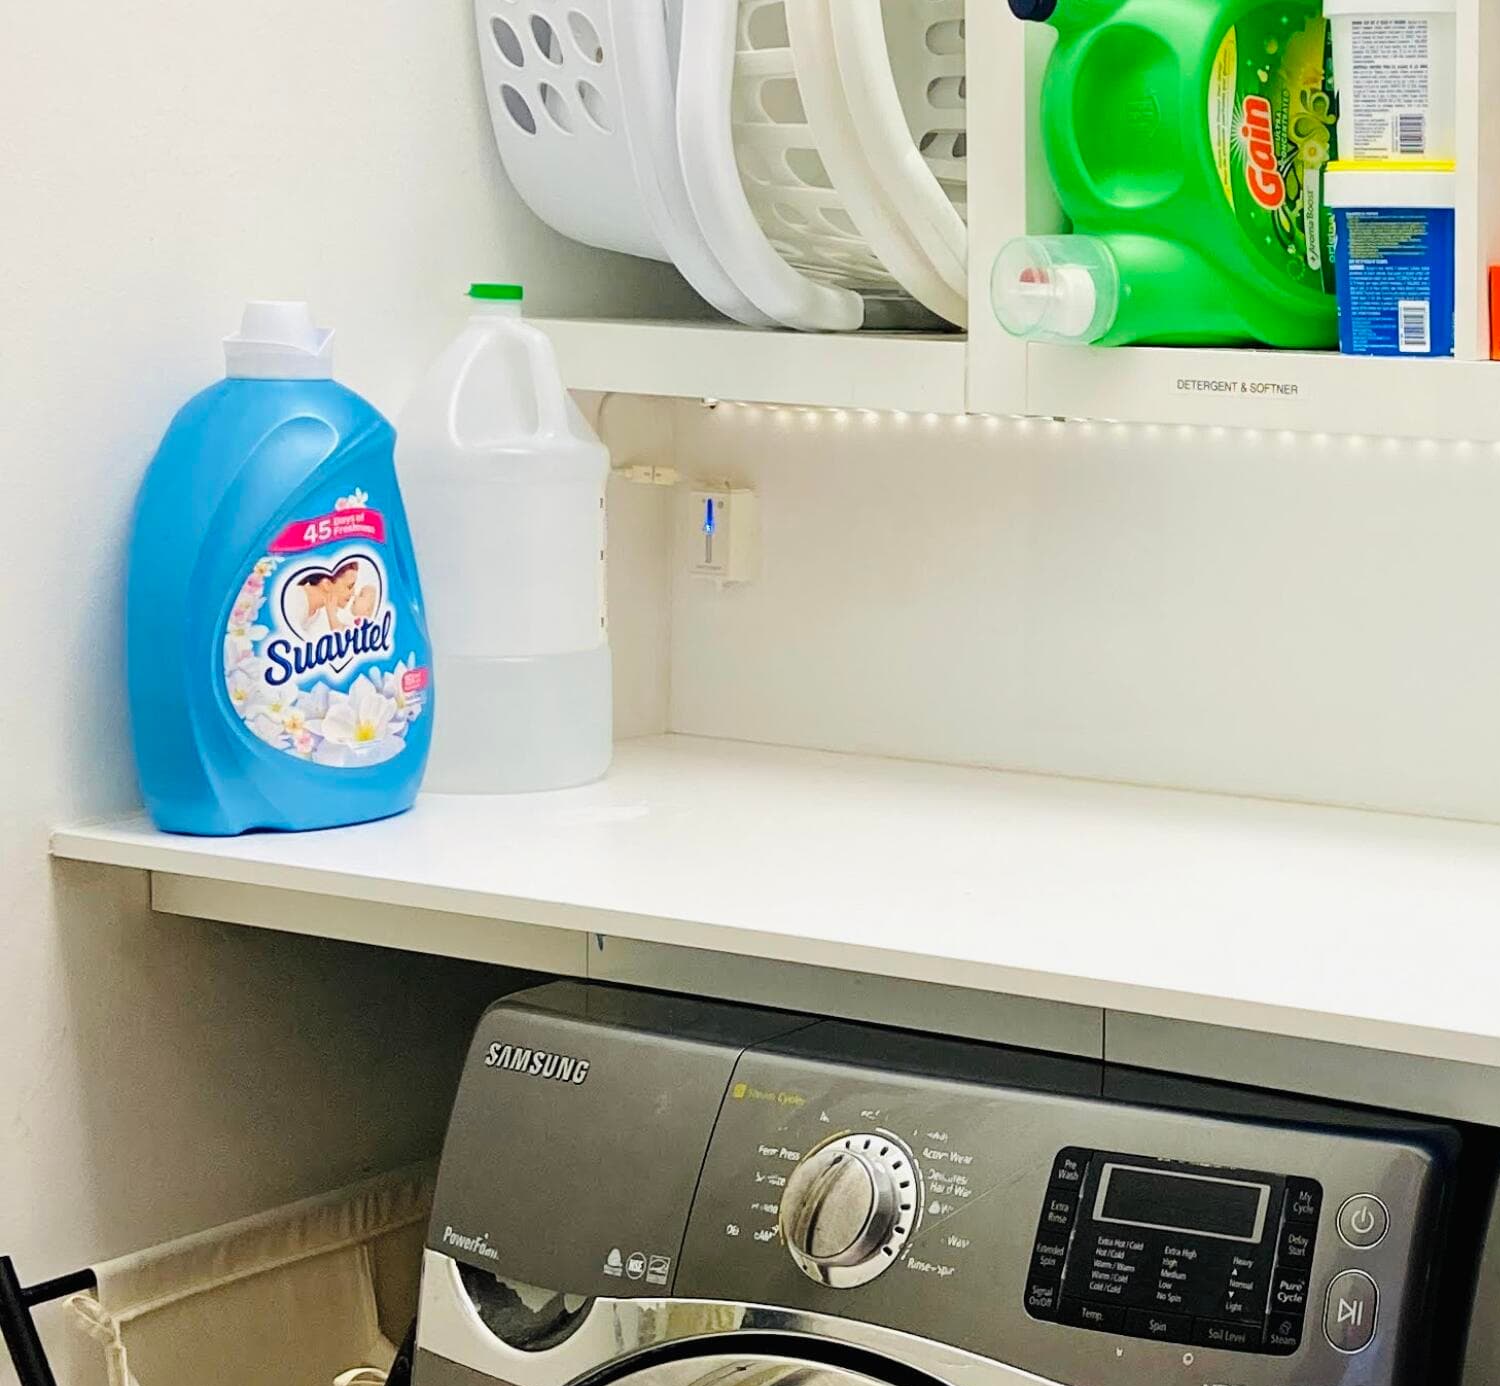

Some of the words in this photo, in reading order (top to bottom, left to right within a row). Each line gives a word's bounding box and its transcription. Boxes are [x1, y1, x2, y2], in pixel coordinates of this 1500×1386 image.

[1273, 112, 1281, 141] ULTRA
[1242, 95, 1286, 210] Gain
[1177, 379, 1237, 392] DETERGENT
[1241, 382, 1247, 392] &
[1249, 383, 1298, 394] SOFTNER
[303, 520, 332, 543] 45
[264, 611, 391, 686] Suavitel
[484, 1042, 590, 1084] SAMSUNG
[1058, 1169, 1079, 1181] Wash
[1299, 1191, 1312, 1206] My
[1051, 1200, 1069, 1212] Extra
[1293, 1202, 1314, 1216] Cycle
[1048, 1212, 1067, 1224] Rinse
[1288, 1234, 1309, 1248] Delay
[1164, 1246, 1181, 1256] Extra
[1182, 1249, 1197, 1260] High
[1288, 1246, 1305, 1257] Start
[1040, 1255, 1056, 1266] Spin
[1233, 1256, 1254, 1269] Heavy
[1160, 1269, 1187, 1280] Medium
[1159, 1280, 1172, 1289] Low
[1229, 1279, 1254, 1290] Normal
[1280, 1280, 1303, 1291] Pure
[1277, 1293, 1303, 1303] Cycle
[1225, 1301, 1242, 1313] Light
[1149, 1319, 1167, 1333] Spin
[1208, 1328, 1223, 1340] Soil
[1225, 1331, 1246, 1342] Level
[1270, 1334, 1297, 1345] Steam
